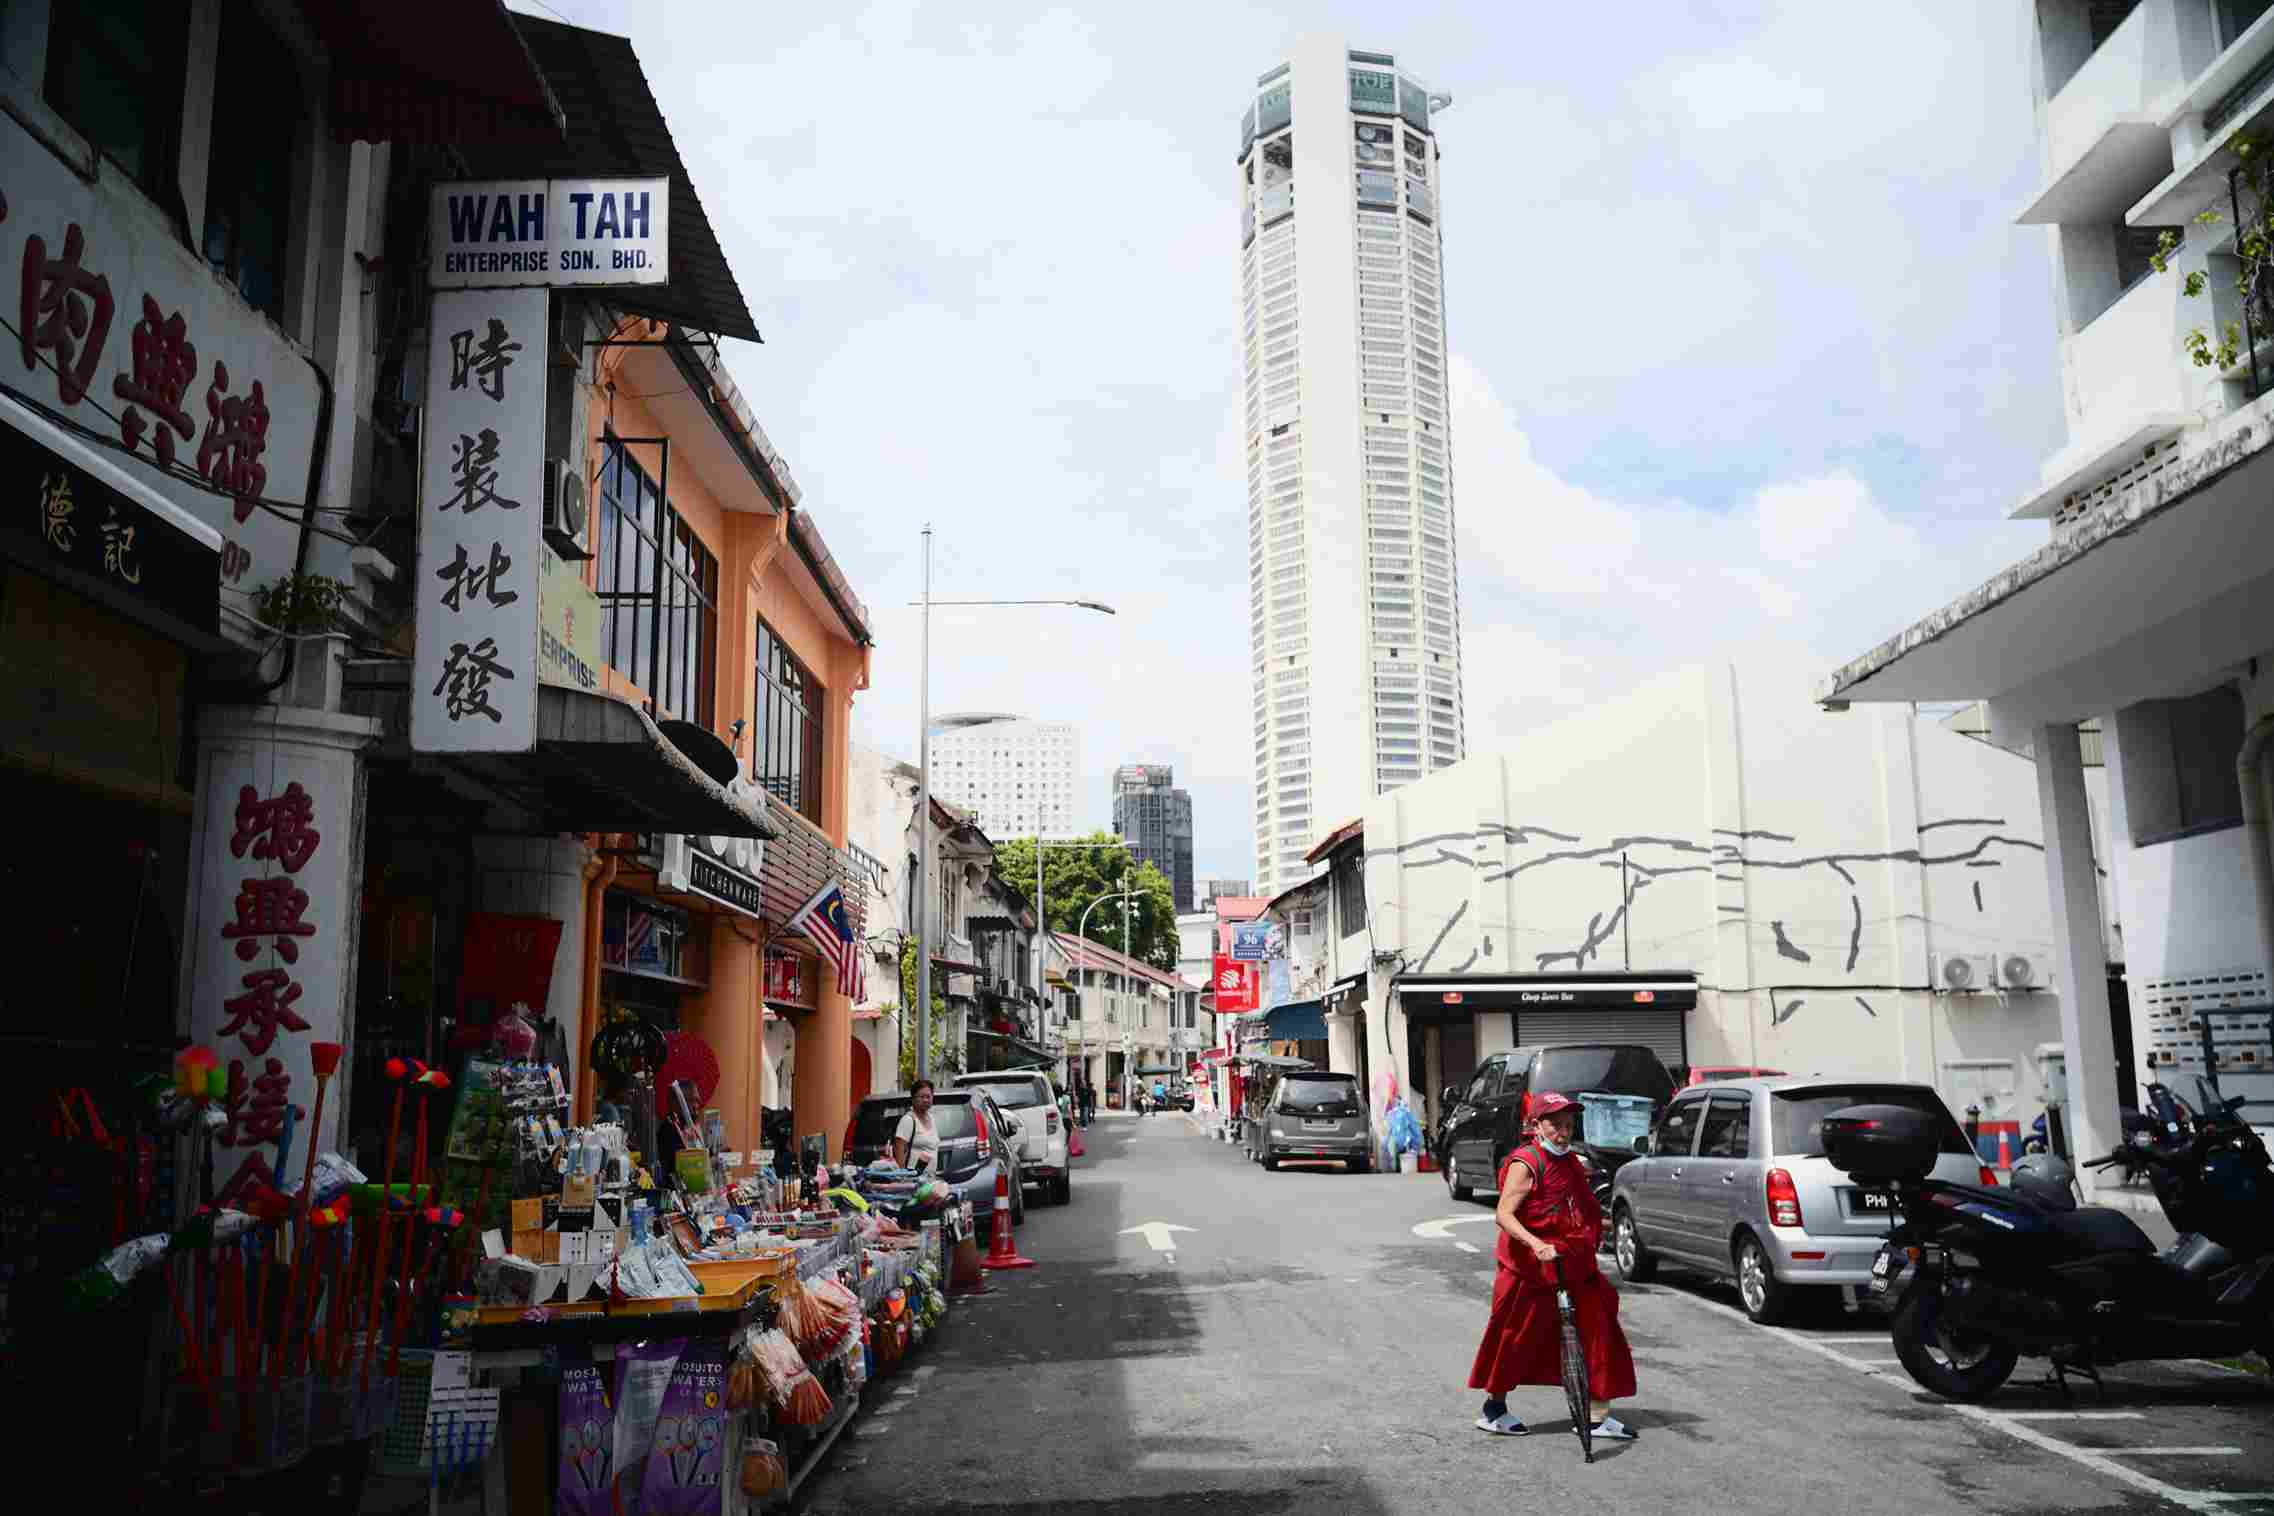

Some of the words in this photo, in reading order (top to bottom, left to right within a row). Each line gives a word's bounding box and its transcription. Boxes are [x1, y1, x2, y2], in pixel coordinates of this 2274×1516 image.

[448, 192, 544, 243] WAH
[569, 192, 649, 239] TAH
[445, 251, 548, 273] ENTERPRISE
[560, 249, 600, 270] SDN.
[612, 249, 652, 269] BHD.
[434, 318, 522, 723] 時裝批發
